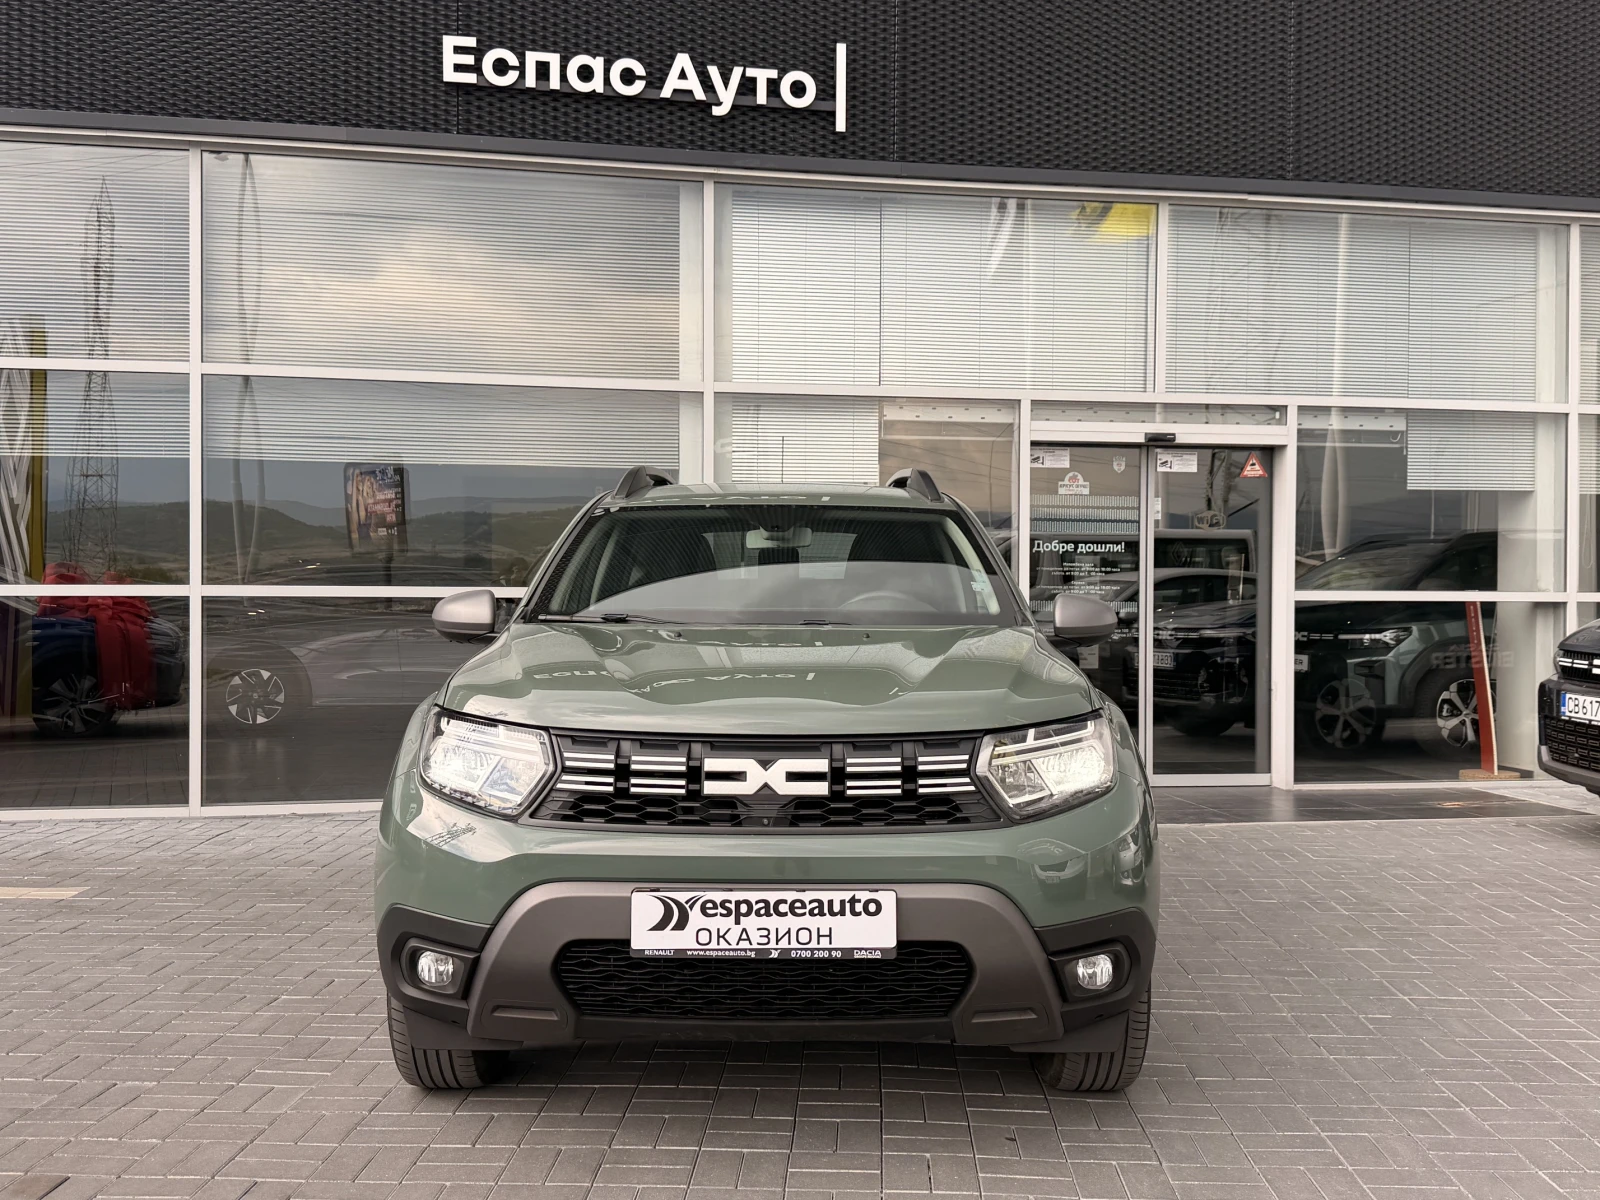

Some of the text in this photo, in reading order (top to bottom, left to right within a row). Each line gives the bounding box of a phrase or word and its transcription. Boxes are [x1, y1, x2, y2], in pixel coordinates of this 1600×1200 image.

[442, 34, 817, 117] Еспас Ауто
[1032, 540, 1125, 554] Добре дошли!
[1567, 697, 1600, 717] CB 617
[699, 893, 883, 925] espaceauto
[695, 926, 833, 947] ОКАЗИОН
[687, 949, 756, 957] www.espaceauto.bg
[791, 950, 811, 958] 0700
[813, 950, 829, 958] 200
[831, 950, 842, 958] 90
